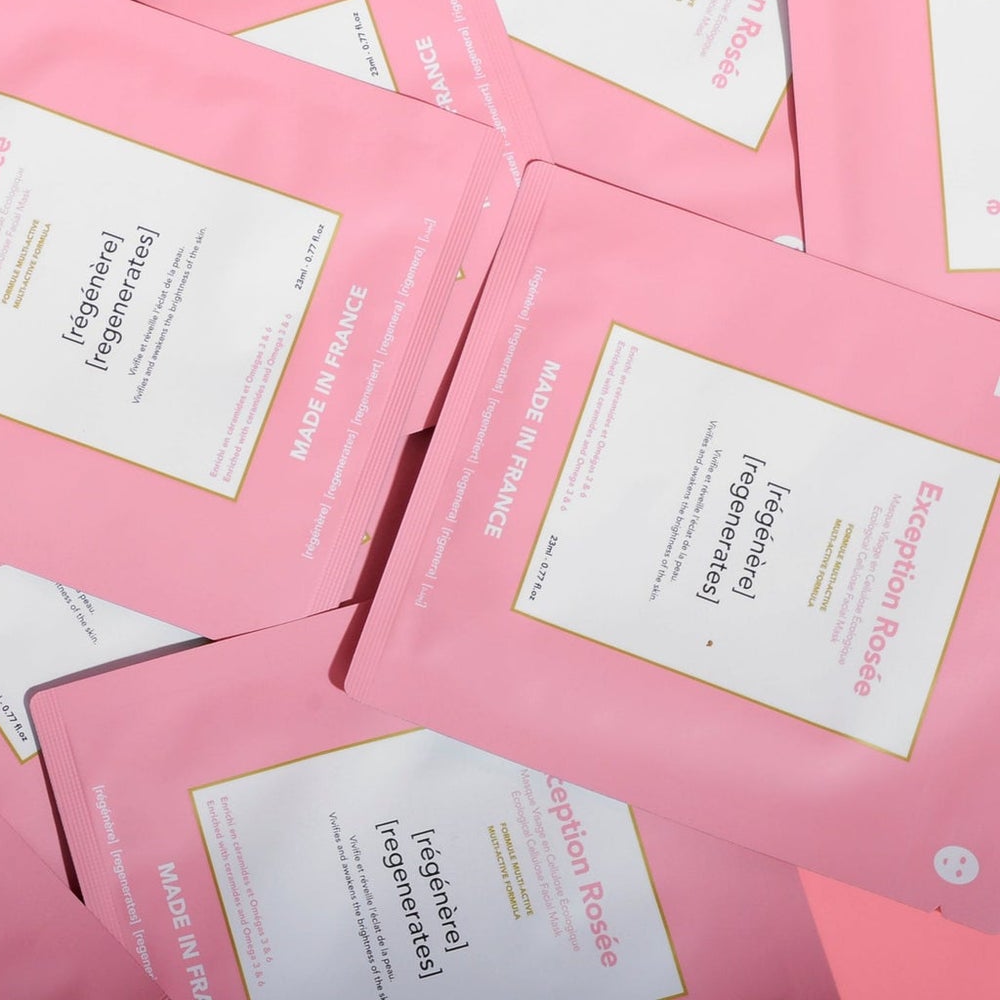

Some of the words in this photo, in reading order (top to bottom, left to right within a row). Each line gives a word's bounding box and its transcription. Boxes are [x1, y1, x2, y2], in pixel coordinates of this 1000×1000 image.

[415, 36, 457, 113] RANCE
[710, 16, 762, 89] Rosée
[61, 230, 125, 345] [régénère]
[84, 225, 160, 371] [regenerates]
[323, 284, 368, 368] FRANCE
[314, 369, 336, 395] IN
[524, 359, 561, 423] MADE
[289, 396, 326, 461] MADE
[514, 425, 537, 451] IN
[483, 454, 527, 539] FRANCE
[695, 453, 766, 604] [regenerates]
[730, 481, 791, 599] [régénère]
[880, 480, 943, 610] Exception
[852, 615, 899, 697] Rosée
[156, 861, 191, 929] MADE
[177, 933, 200, 959] IN
[374, 819, 443, 979] [regenerates]
[410, 828, 469, 953] [régénère]
[499, 822, 517, 860] FORMULE
[511, 861, 533, 916] MULTI-ACTIVE
[578, 881, 619, 968] Rosée
